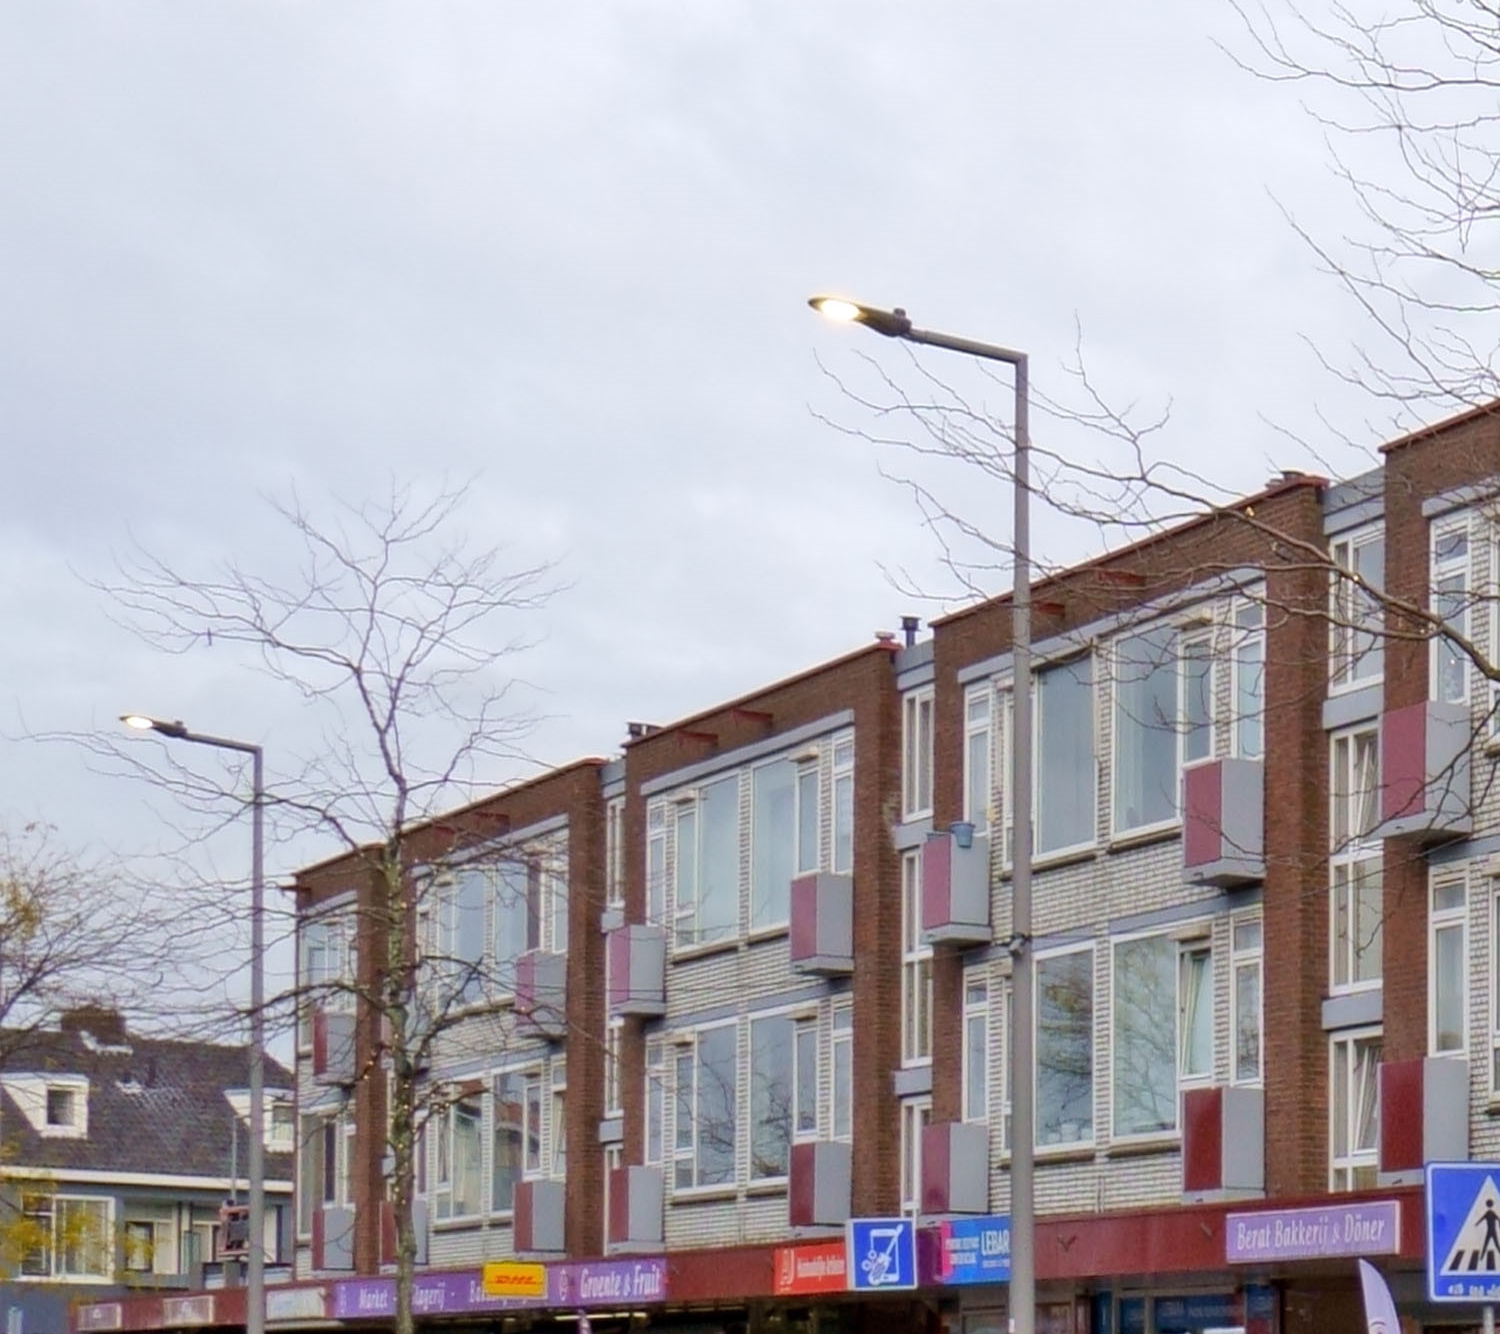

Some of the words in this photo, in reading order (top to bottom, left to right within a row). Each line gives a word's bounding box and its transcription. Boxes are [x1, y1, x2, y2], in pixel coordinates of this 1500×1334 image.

[1236, 1222, 1271, 1251] Berat
[1274, 1217, 1329, 1251] Bakkerij
[1343, 1214, 1384, 1244] Döner
[494, 1274, 537, 1286] DHL
[633, 1264, 660, 1296] Fruit
